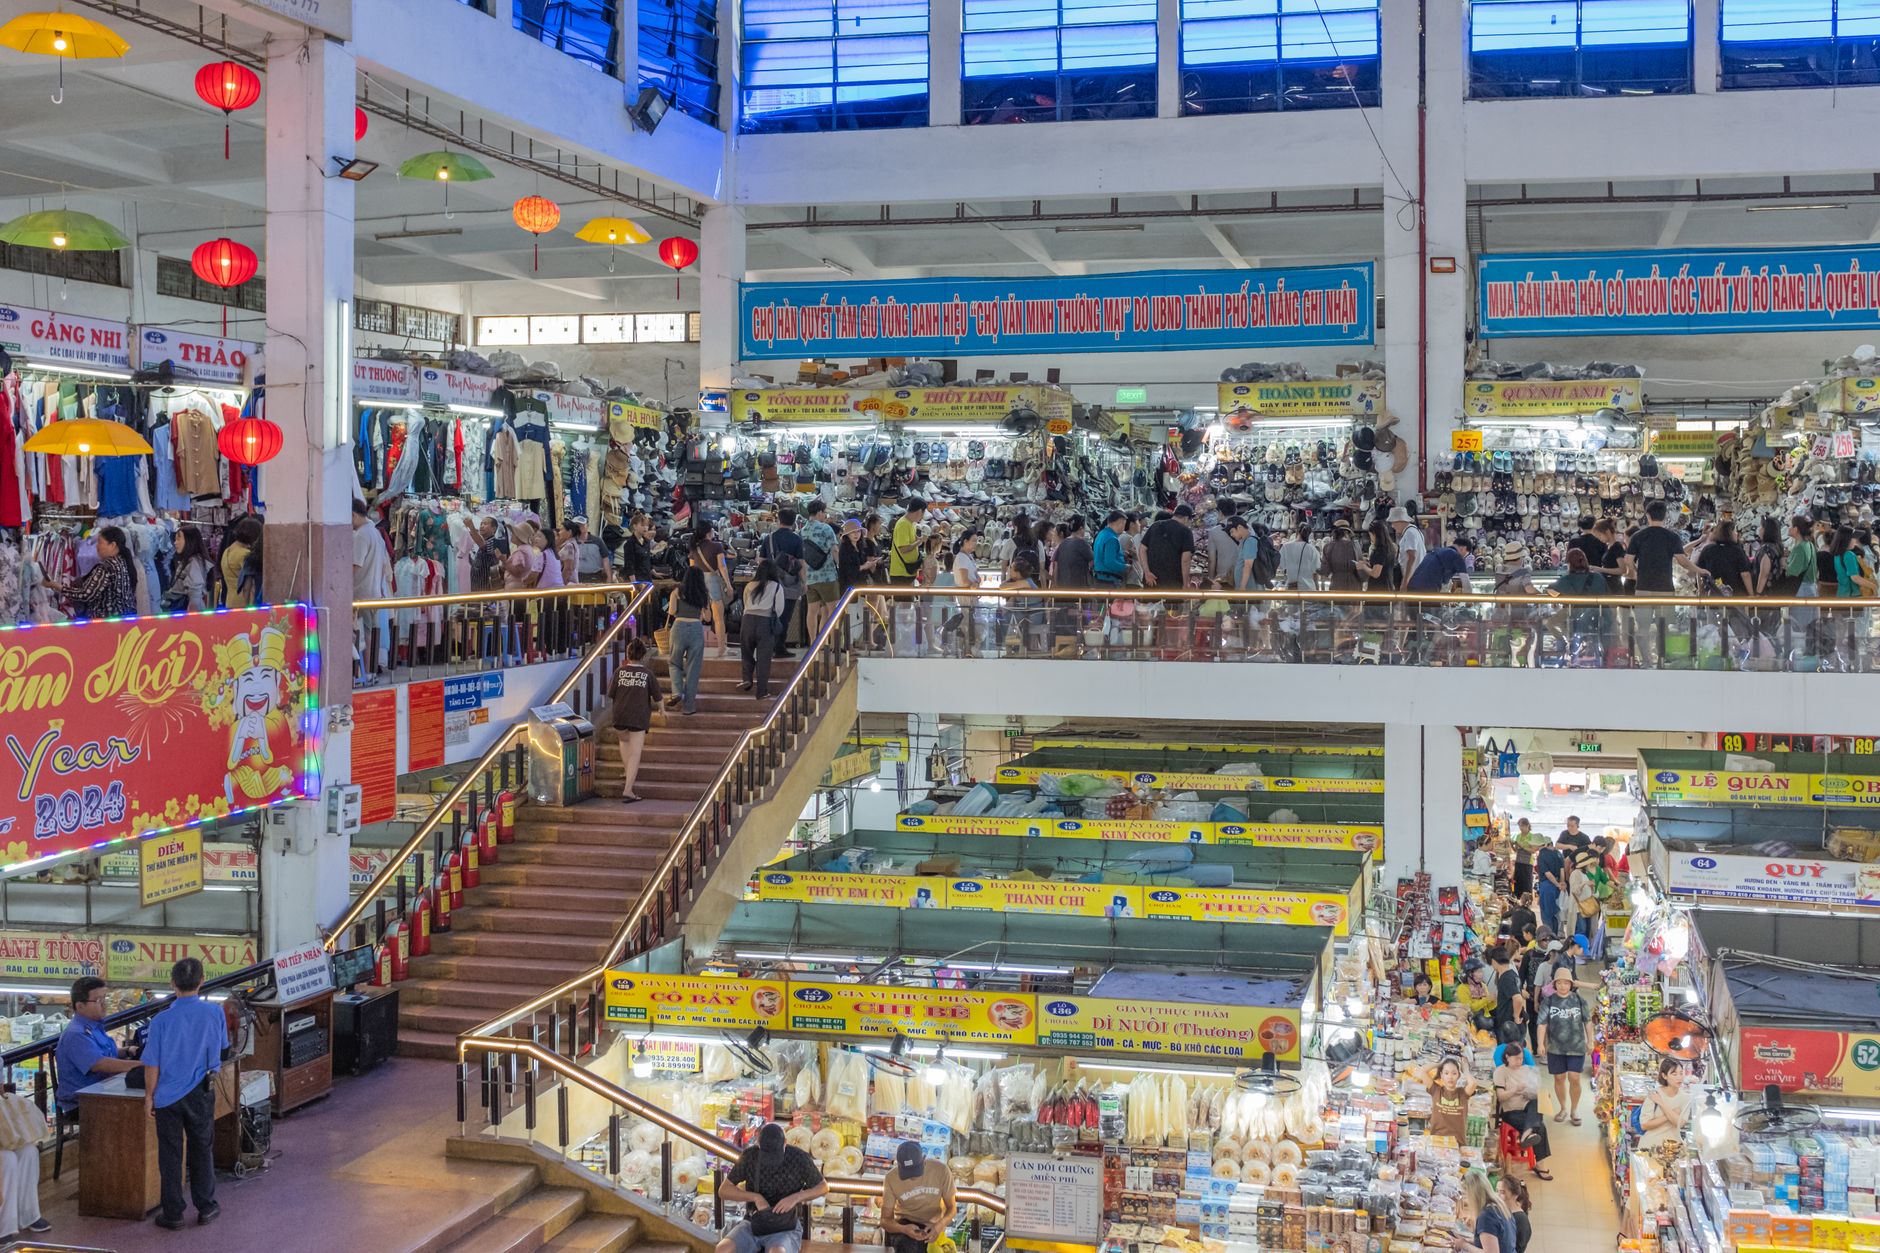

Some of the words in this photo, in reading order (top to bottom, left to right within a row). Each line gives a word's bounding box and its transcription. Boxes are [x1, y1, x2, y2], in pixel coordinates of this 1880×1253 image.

[1487, 281, 1515, 319] MUA
[1516, 272, 1542, 318] BÁN
[1543, 271, 1577, 318] HÀNG
[1578, 270, 1605, 318] HÓA
[1606, 269, 1624, 317] CÓ
[1626, 264, 1668, 316] NGUỒN
[1670, 262, 1696, 315] GỐC
[1697, 262, 1731, 314] XUẤT
[1731, 266, 1750, 313] XỨ
[1752, 265, 1770, 313] RÕ
[1771, 265, 1806, 312] RÀNG
[1807, 263, 1825, 311] LÀ
[1825, 258, 1868, 320] QUYỀN
[752, 302, 775, 348] CHỢ
[776, 298, 798, 341] HÀN
[800, 293, 833, 346] QUYẾT
[834, 297, 858, 338] TÂM
[860, 296, 879, 338] GIỮ
[880, 295, 909, 337] VŨNG
[911, 302, 940, 338] DANH
[943, 293, 967, 344] HIỆU
[1002, 293, 1023, 335] VĂN
[1025, 300, 1055, 335] MINH
[1056, 293, 1100, 334] THƯƠNG
[1134, 297, 1149, 332] DO
[1151, 295, 1182, 331] UBND
[1185, 285, 1222, 330] THÀNH
[1225, 280, 1250, 328] PHỐ
[1250, 282, 1266, 328] ĐÀ
[1268, 278, 1300, 327] NẴNG
[1302, 289, 1322, 325] GHI
[1325, 280, 1357, 333] NHẬN
[91, 328, 122, 349] NHI
[179, 340, 246, 368] THẢO
[967, 391, 1009, 404] LINH
[1568, 385, 1608, 398] ANH
[803, 395, 829, 406] KIM
[863, 403, 879, 411] 260
[1051, 424, 1067, 432] 259
[1456, 438, 1479, 449] 257
[1835, 434, 1853, 457] 256
[1813, 445, 1827, 457] 256
[1580, 744, 1598, 752] EXIT
[1724, 735, 1743, 752] 89
[1855, 738, 1873, 755] 89
[6, 730, 141, 801] Year
[1690, 773, 1718, 790] LỆ
[1727, 775, 1790, 791] QUÂN
[34, 781, 126, 840] 2024
[1101, 830, 1128, 839] KIM
[1697, 859, 1711, 868] 64
[231, 870, 256, 878] RAU
[807, 884, 844, 897] THÚY
[849, 887, 867, 898] EM
[1004, 893, 1055, 905] THANH
[1059, 895, 1085, 906] CHI
[45, 932, 101, 962] TÙNG
[116, 945, 130, 953] 139
[651, 990, 683, 1003] CÔ
[837, 989, 864, 998] GIA
[852, 1001, 916, 1017] CHỊ
[1116, 1005, 1138, 1013] GIA
[1156, 1007, 1192, 1017] THỰC
[1194, 1008, 1229, 1019] PHẨM
[1092, 1015, 1111, 1031] DÌ
[1119, 1017, 1169, 1034] NUÔI
[1173, 1022, 1255, 1042] (Thương)
[1096, 1037, 1114, 1047] TÔM
[1122, 1038, 1134, 1048] CÁ
[1142, 1040, 1162, 1051] MỰC
[1184, 1042, 1201, 1052] KHÔ
[1204, 1043, 1222, 1055] CÁC
[1224, 1045, 1243, 1056] LOẠI
[1857, 1044, 1879, 1065] 52
[1013, 1160, 1034, 1170] CÂN
[1058, 1161, 1094, 1175] CHỨNG
